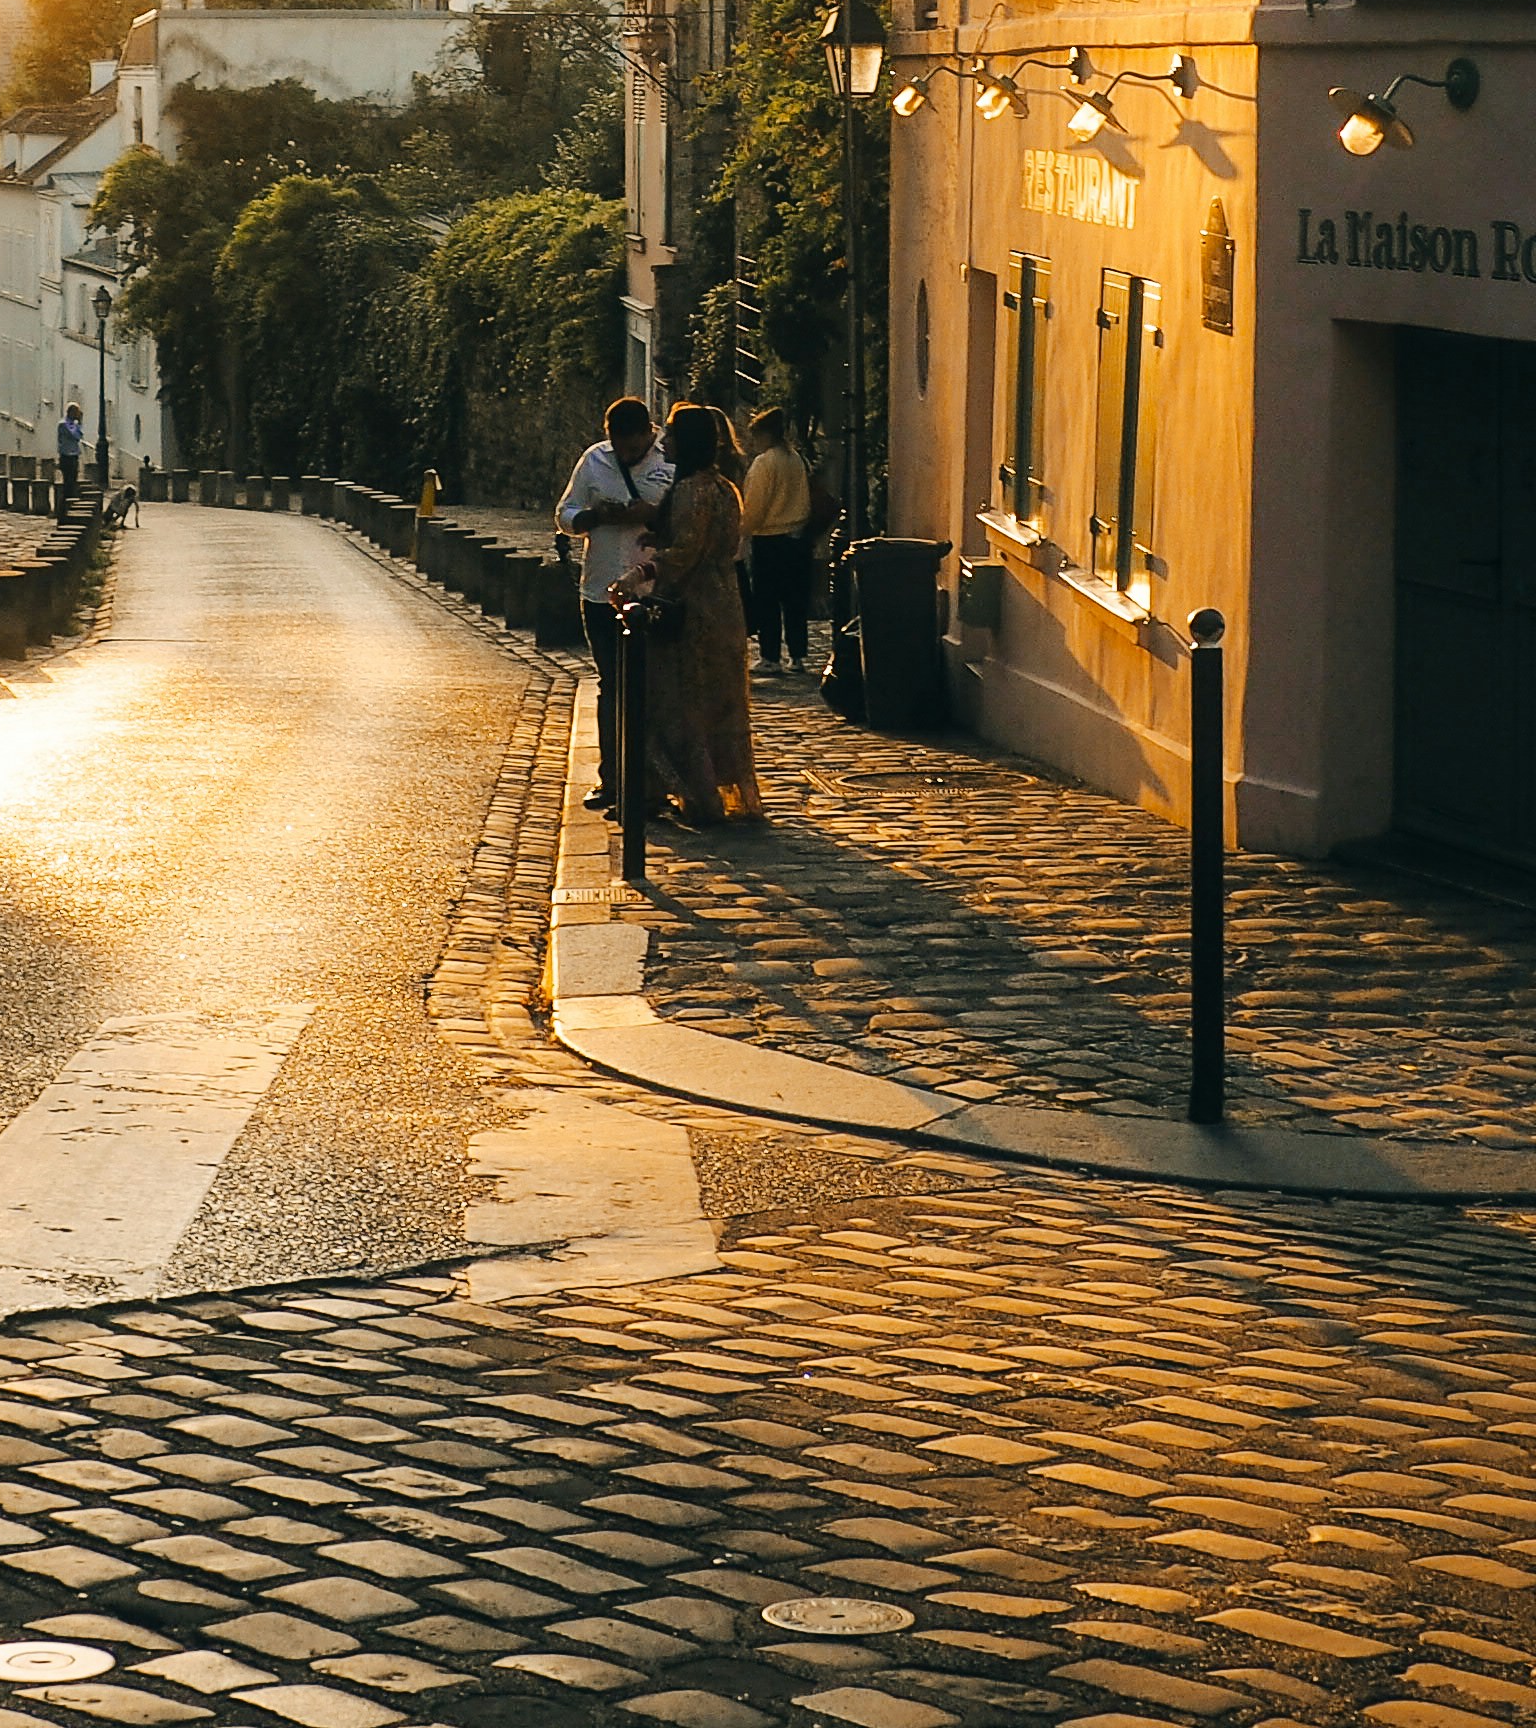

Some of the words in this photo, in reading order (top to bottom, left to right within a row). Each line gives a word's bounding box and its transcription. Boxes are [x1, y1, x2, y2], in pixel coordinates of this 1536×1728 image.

[1021, 148, 1141, 229] RESTAURANT
[1296, 207, 1339, 265] La
[1345, 210, 1481, 278] Maison
